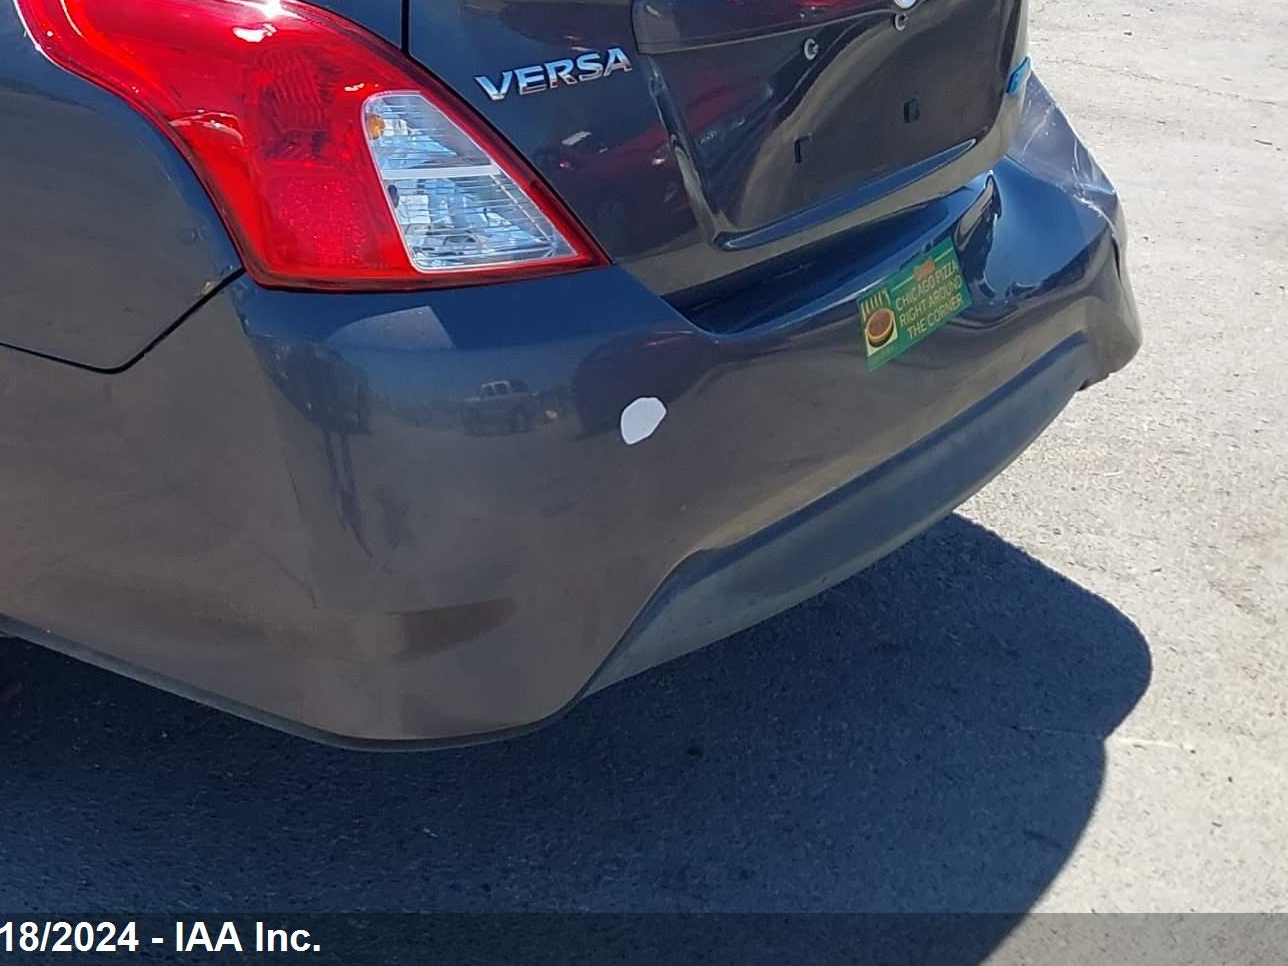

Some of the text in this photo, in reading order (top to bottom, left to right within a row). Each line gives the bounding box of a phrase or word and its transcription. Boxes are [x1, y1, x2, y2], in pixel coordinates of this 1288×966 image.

[474, 47, 633, 101] VERSA
[895, 258, 959, 312] CHICAGO PIZZA
[899, 274, 962, 327] RIGHT AROUND
[907, 292, 962, 339] THE CORNER
